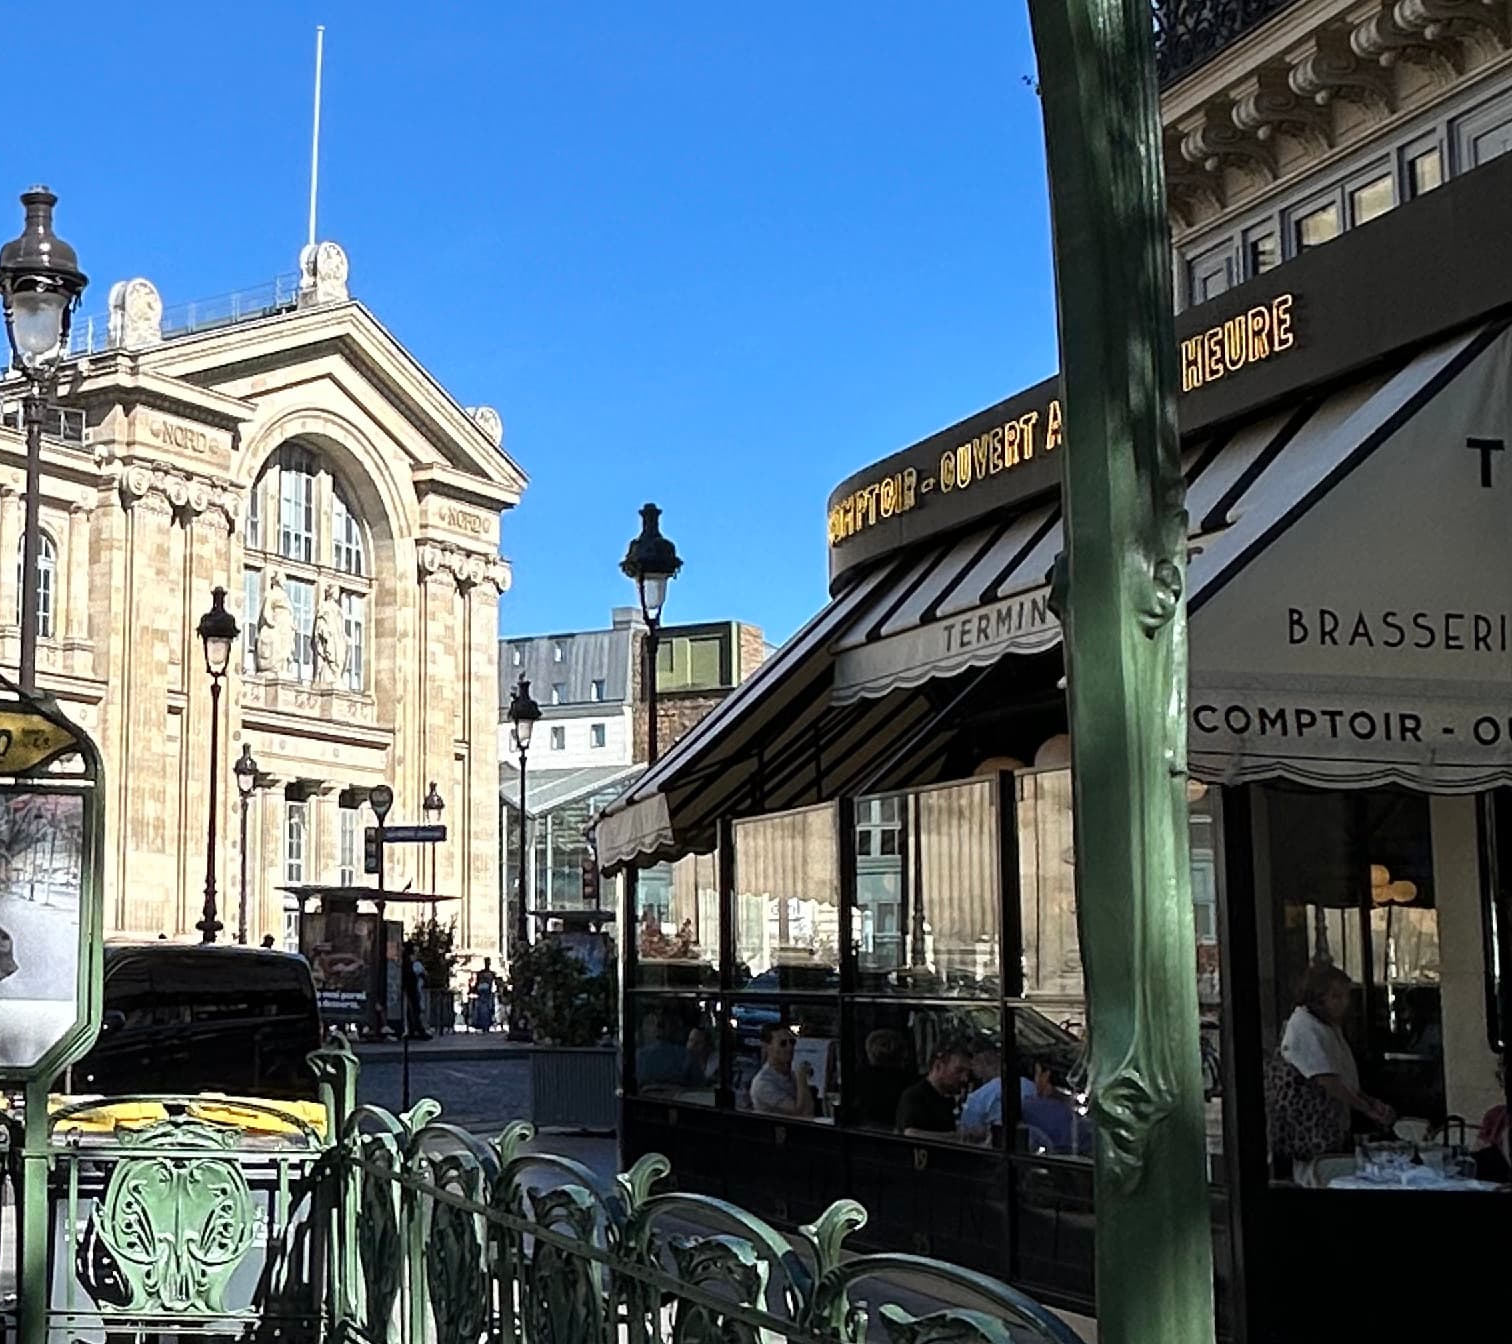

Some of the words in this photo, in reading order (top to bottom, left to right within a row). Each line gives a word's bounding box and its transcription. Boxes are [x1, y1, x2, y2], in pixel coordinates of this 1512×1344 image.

[939, 410, 1039, 495] OUVERT
[1180, 293, 1294, 392] HEURE
[1465, 437, 1505, 488] T
[943, 594, 1048, 652] TERMIN
[1287, 608, 1507, 652] BRASSERI
[1192, 704, 1422, 742] COMPTOIR
[1473, 715, 1512, 746] O
